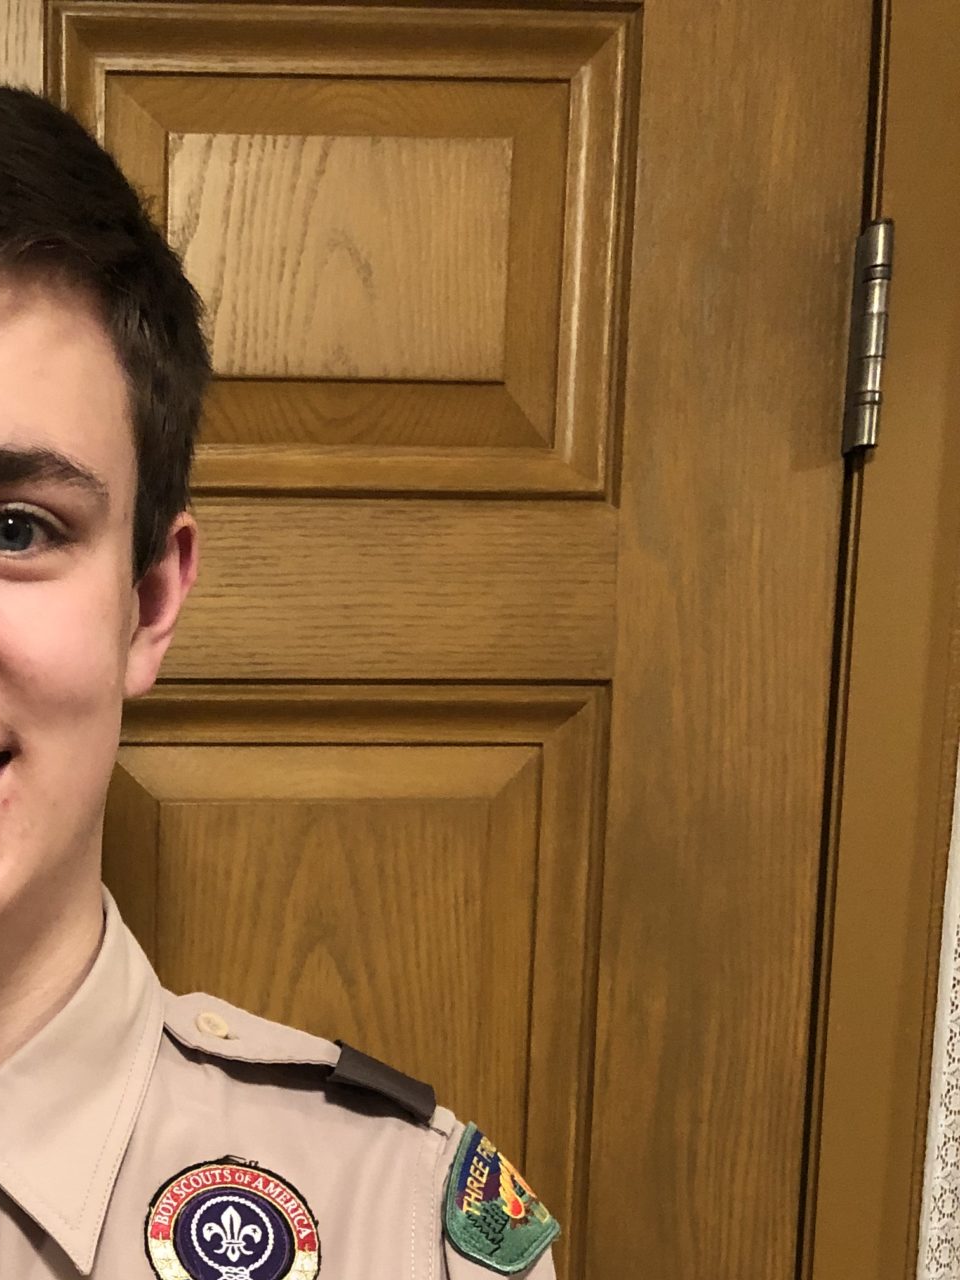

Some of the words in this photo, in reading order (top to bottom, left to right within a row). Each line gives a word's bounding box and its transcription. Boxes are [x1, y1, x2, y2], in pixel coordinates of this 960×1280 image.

[155, 1195, 176, 1226] BOY
[174, 1169, 232, 1197] SCOUTS
[234, 1171, 253, 1184] OF
[252, 1178, 312, 1239] AMERICA
[462, 1156, 489, 1216] THREE
